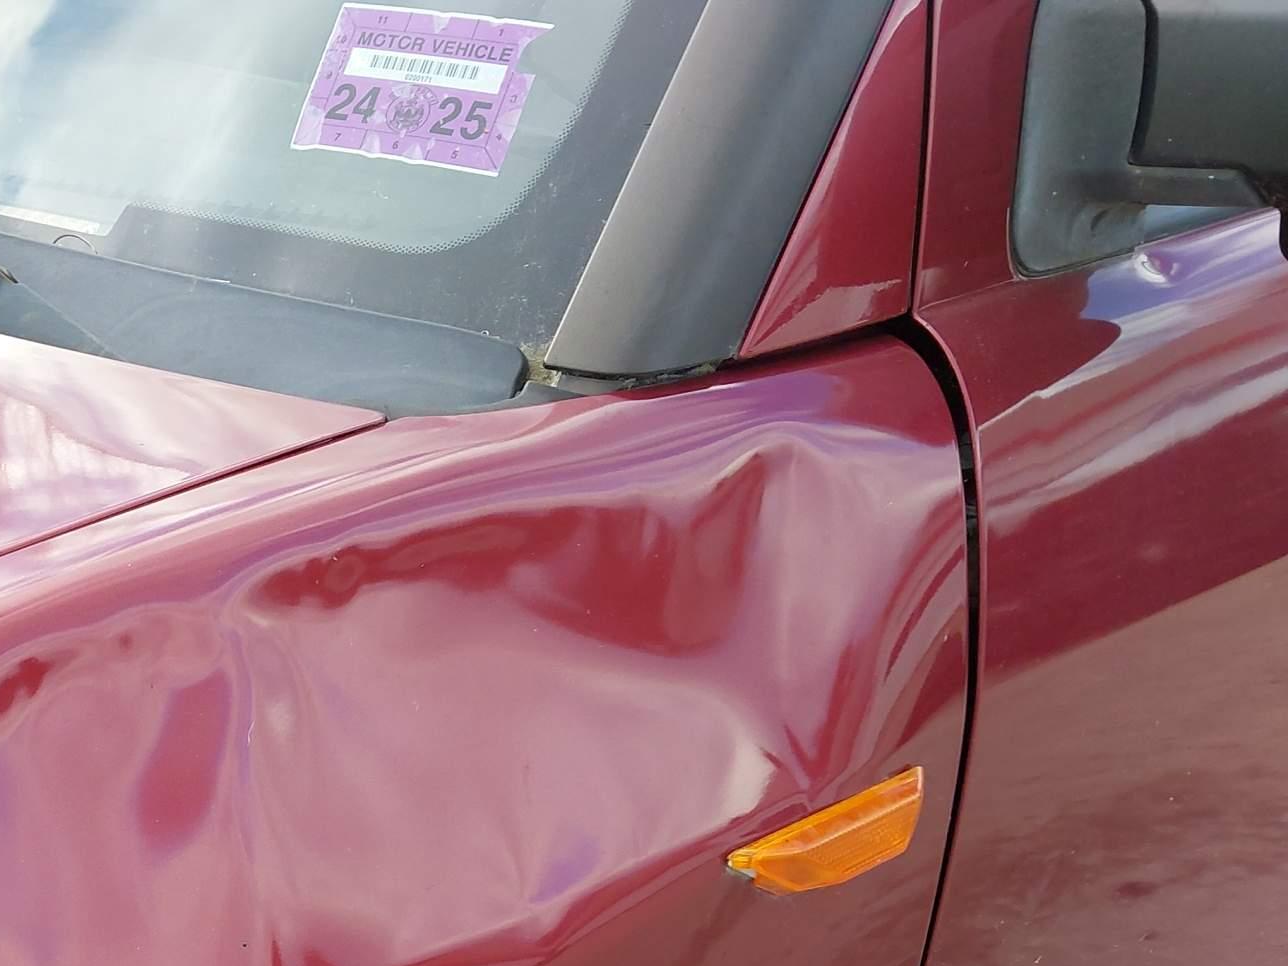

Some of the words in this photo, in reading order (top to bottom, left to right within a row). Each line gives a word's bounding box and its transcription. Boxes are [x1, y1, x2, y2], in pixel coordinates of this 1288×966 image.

[377, 16, 389, 24] 11
[357, 31, 425, 52] MOTOR
[432, 39, 514, 63] VEHICLE
[324, 83, 381, 124] 24
[429, 96, 493, 140] 25
[334, 132, 342, 142] 7
[392, 140, 400, 150] 6
[450, 150, 460, 160] 5
